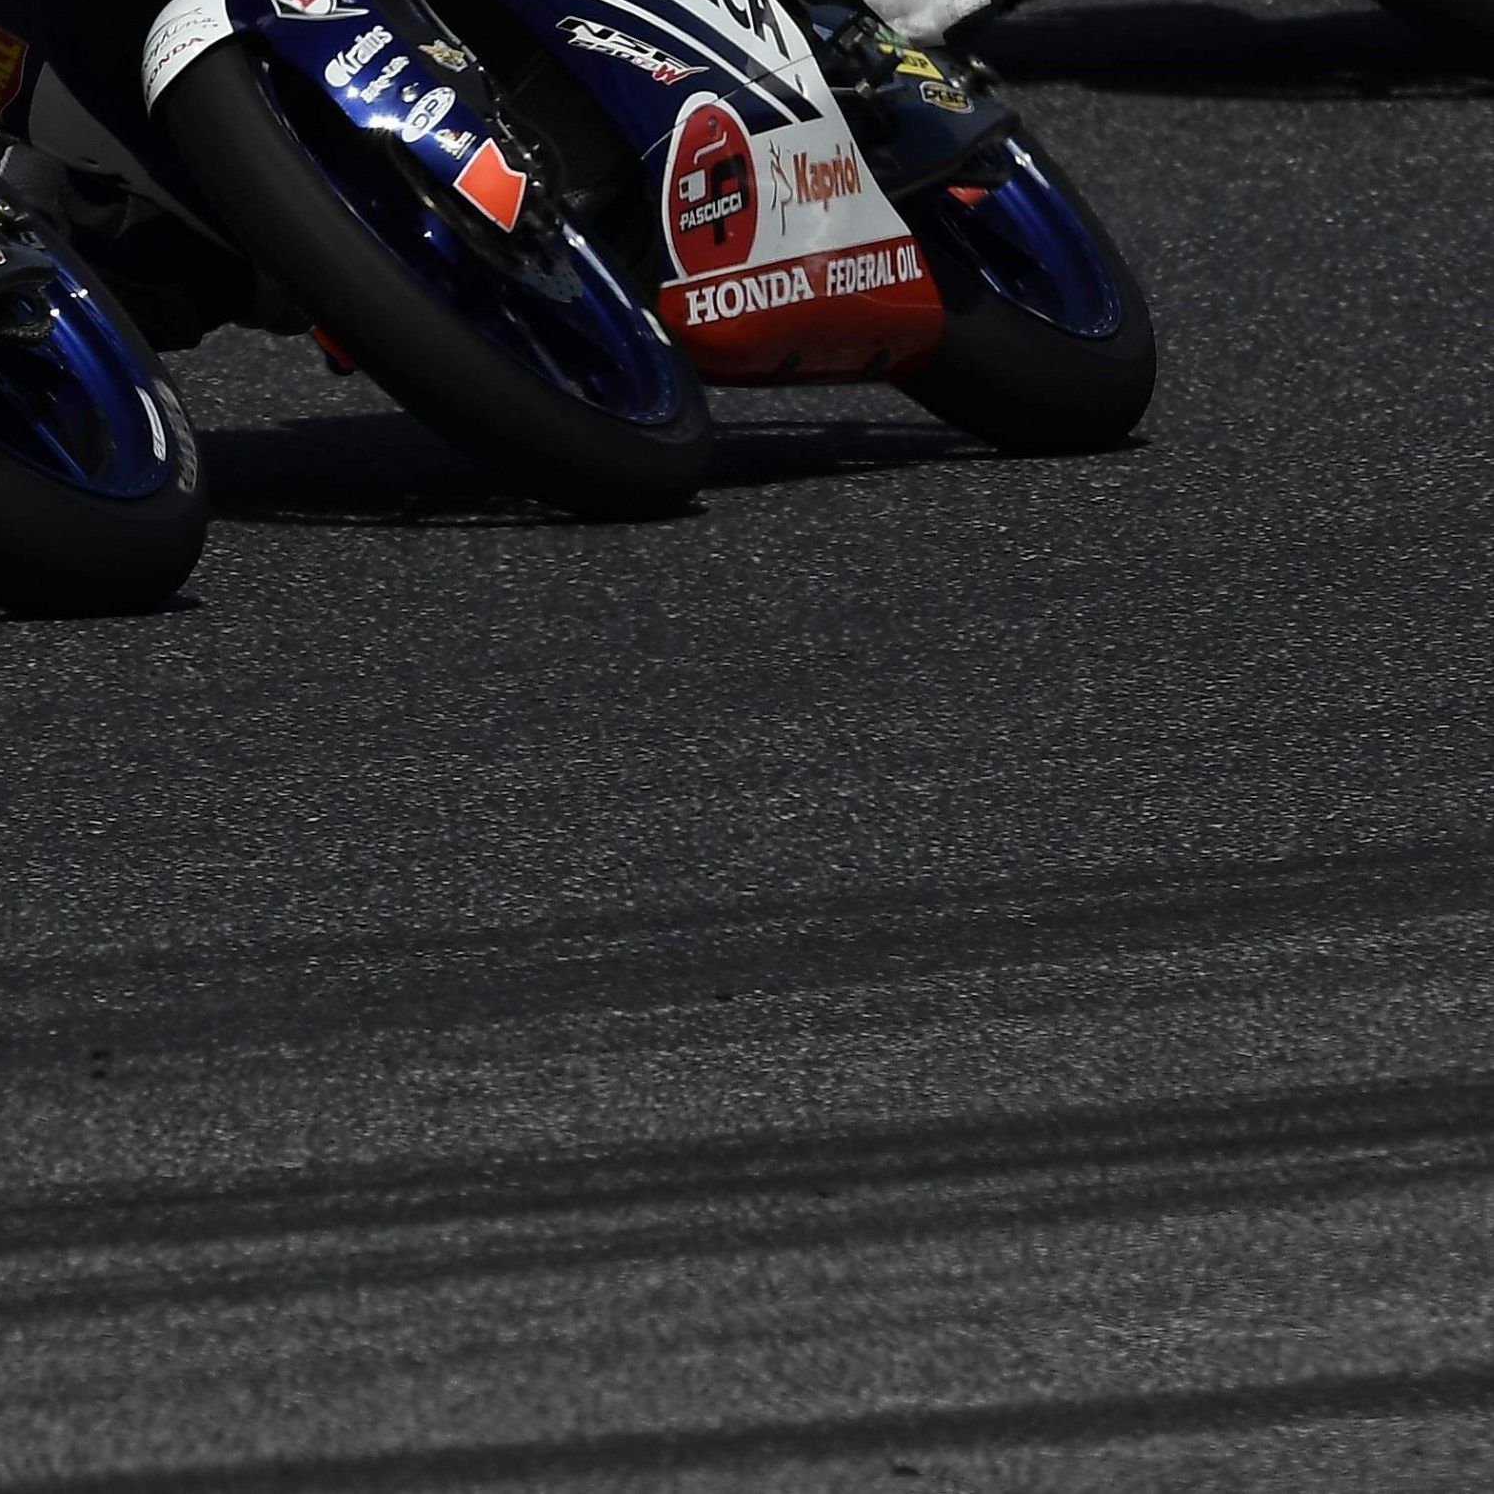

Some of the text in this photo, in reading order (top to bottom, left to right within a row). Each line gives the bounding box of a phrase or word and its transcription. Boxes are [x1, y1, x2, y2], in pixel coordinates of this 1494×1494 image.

[678, 191, 743, 232] PASCUCCI
[685, 244, 923, 327] HONDA FEDERAL OIL
